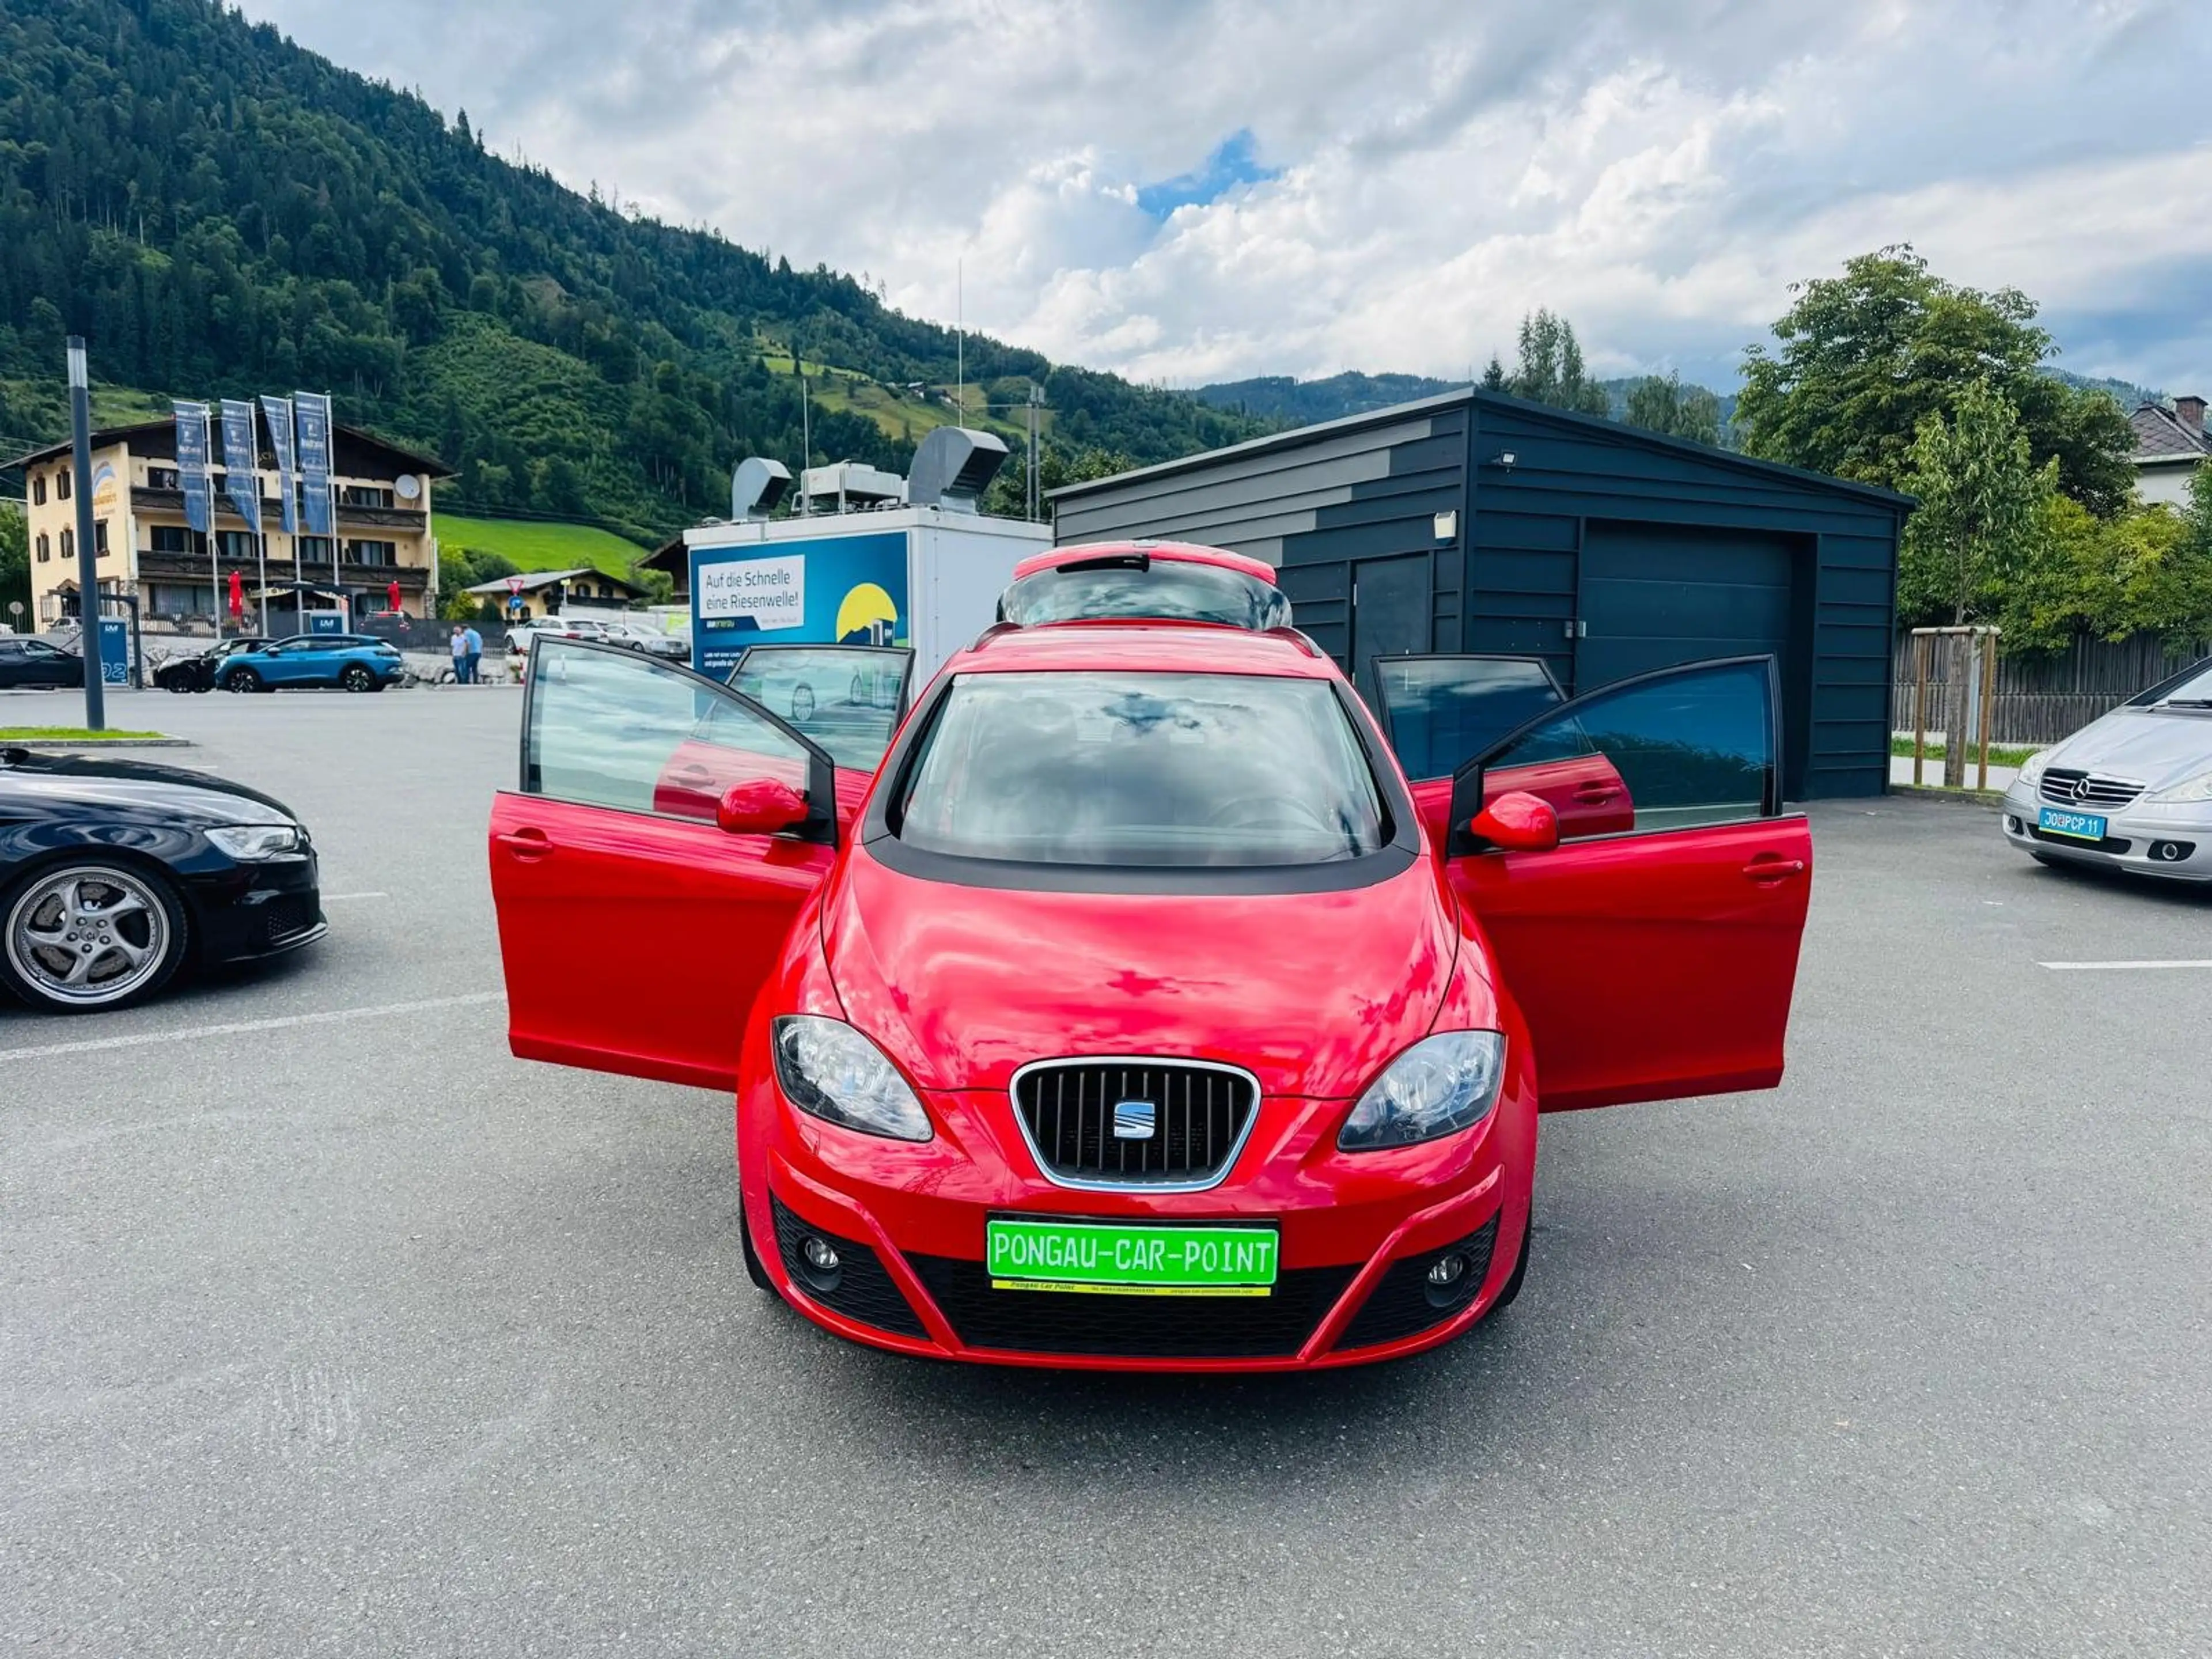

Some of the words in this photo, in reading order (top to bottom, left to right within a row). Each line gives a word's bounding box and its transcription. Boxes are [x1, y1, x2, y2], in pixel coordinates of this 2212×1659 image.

[706, 573, 725, 588] Auf
[726, 572, 742, 587] die
[745, 568, 790, 586] Schnelle
[706, 594, 728, 609] eine
[730, 590, 798, 609] Riesenwelle!
[2064, 815, 2085, 831] PCP
[2088, 819, 2098, 834] 11
[994, 1233, 1271, 1273] PONGAU-CAR-POINT
